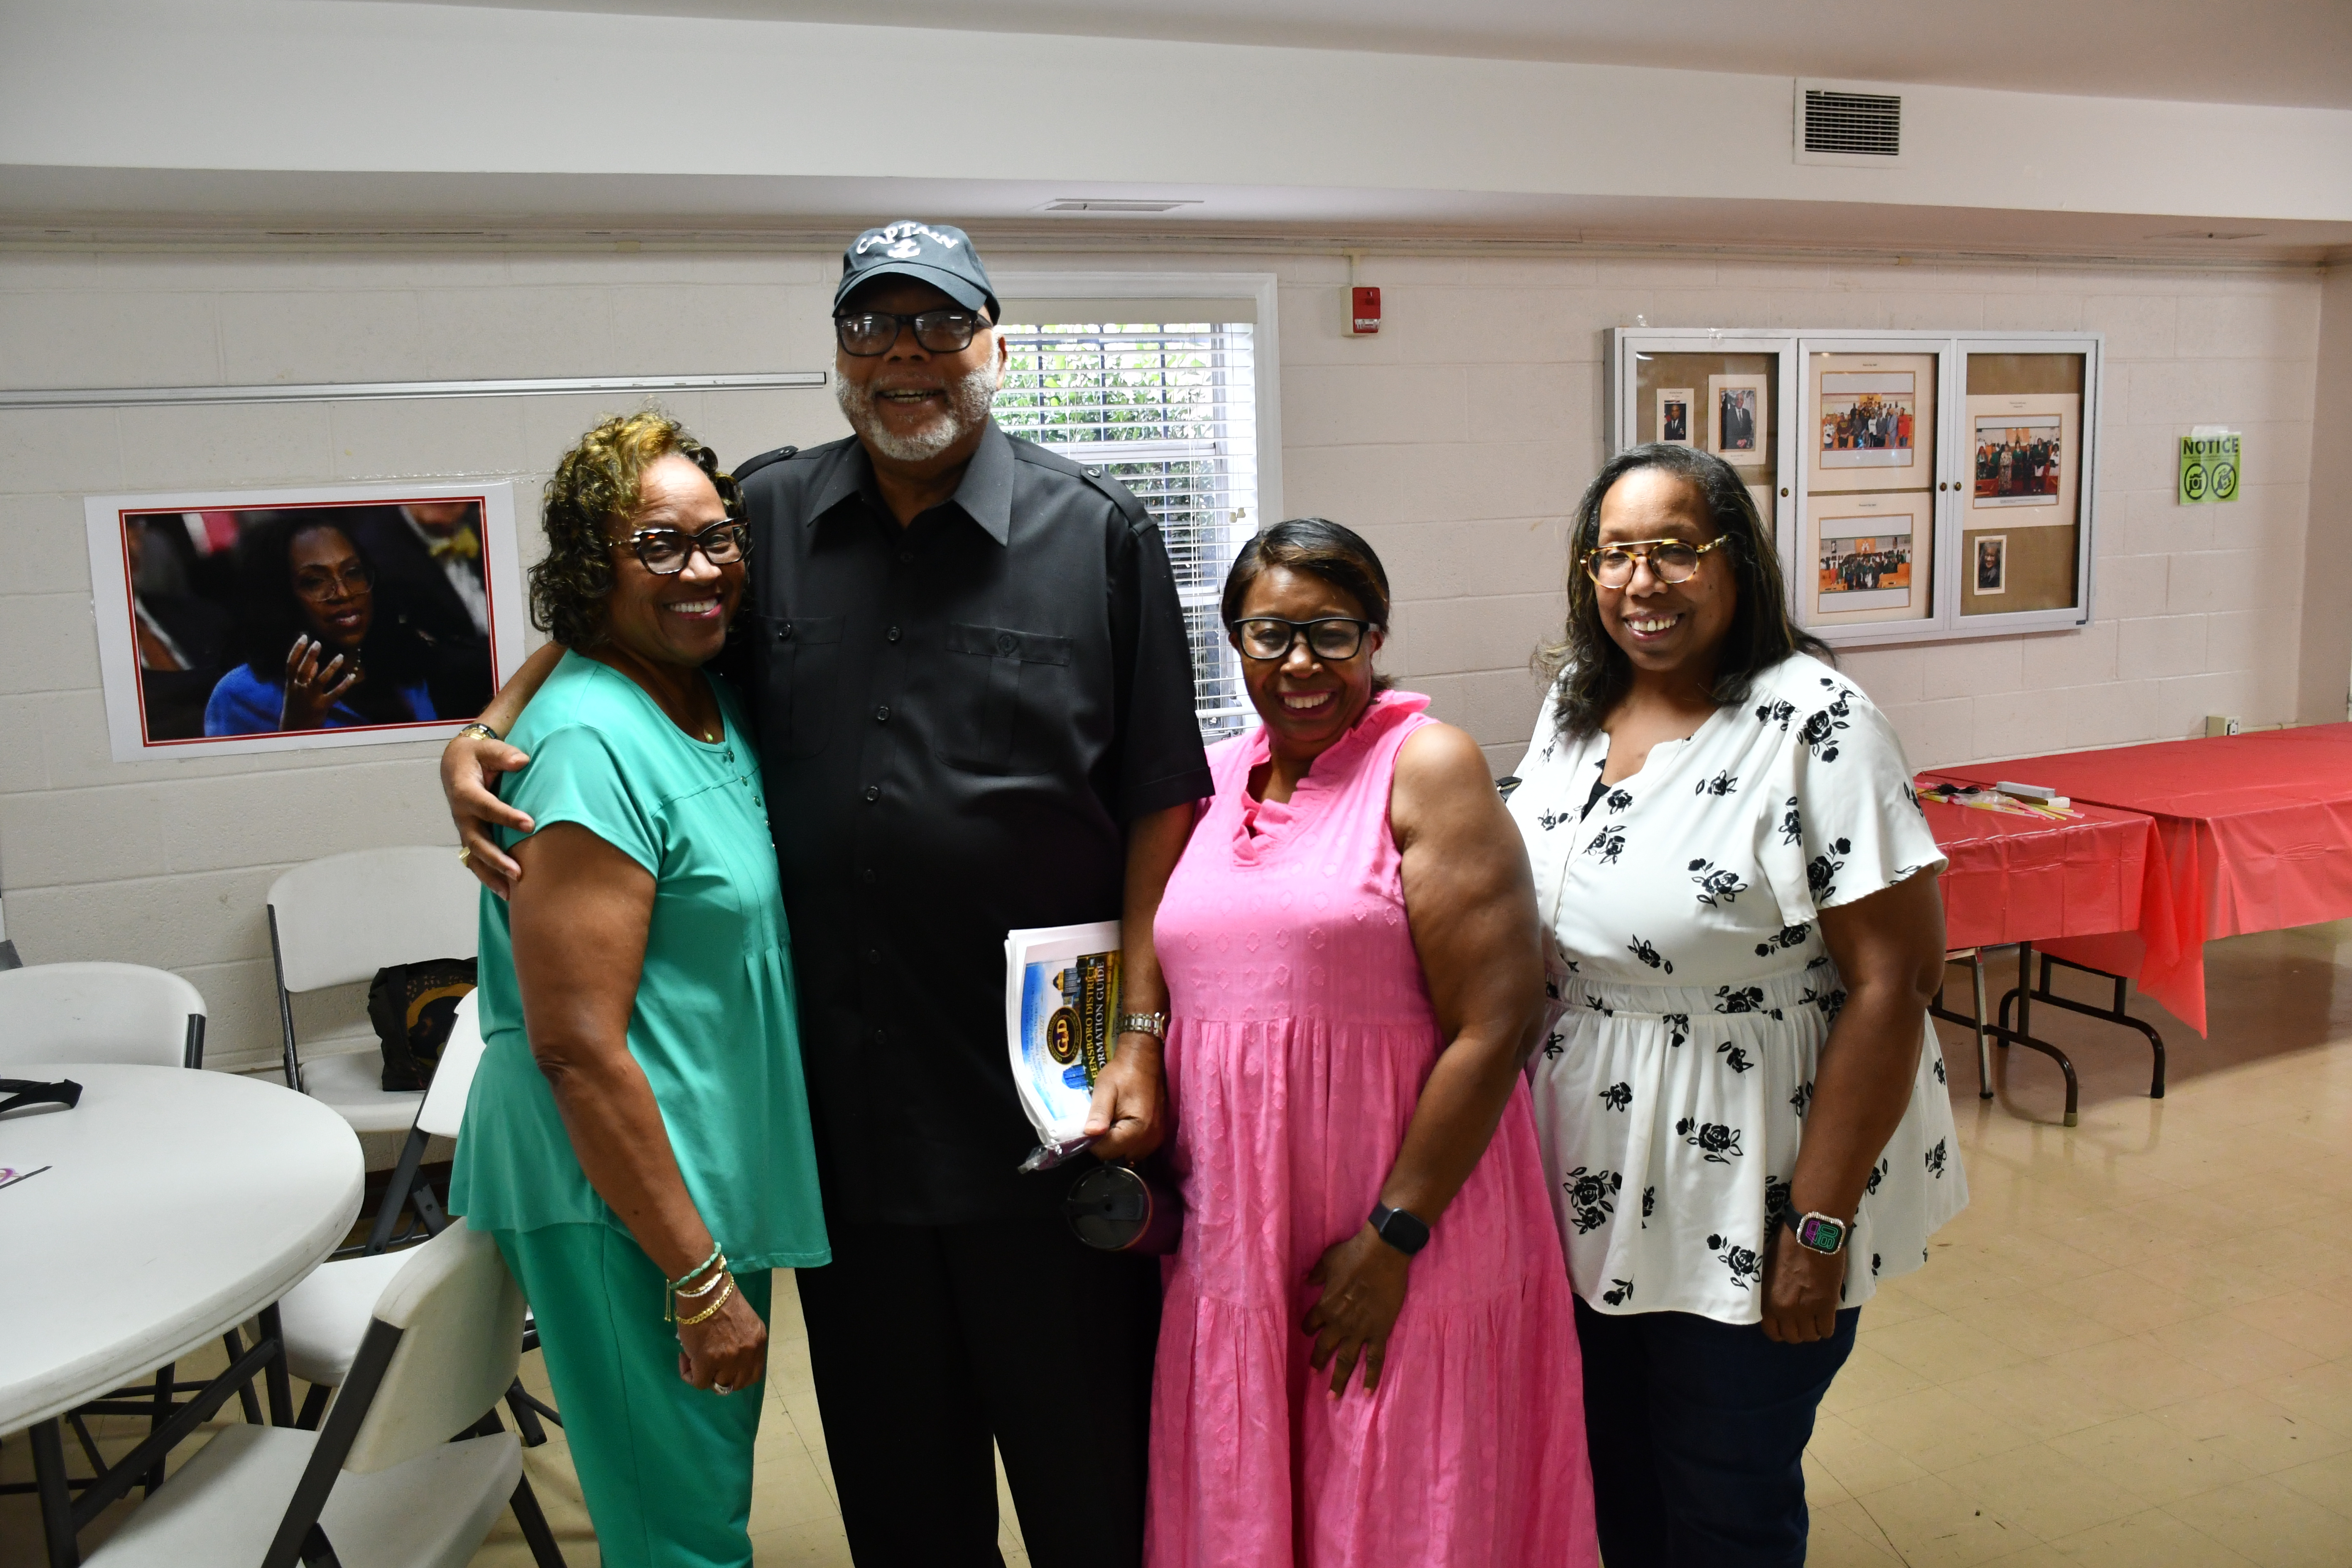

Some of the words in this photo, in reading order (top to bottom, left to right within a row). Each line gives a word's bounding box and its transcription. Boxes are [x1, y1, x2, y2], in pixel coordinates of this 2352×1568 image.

[856, 223, 959, 254] CAPTAIN
[2183, 438, 2238, 455] NOTICE
[1086, 965, 1094, 1015] DISTRICT
[1096, 962, 1104, 1000] GUIDE
[1086, 1018, 1099, 1078] EENSBORO
[1095, 1004, 1106, 1069] ORMATION
